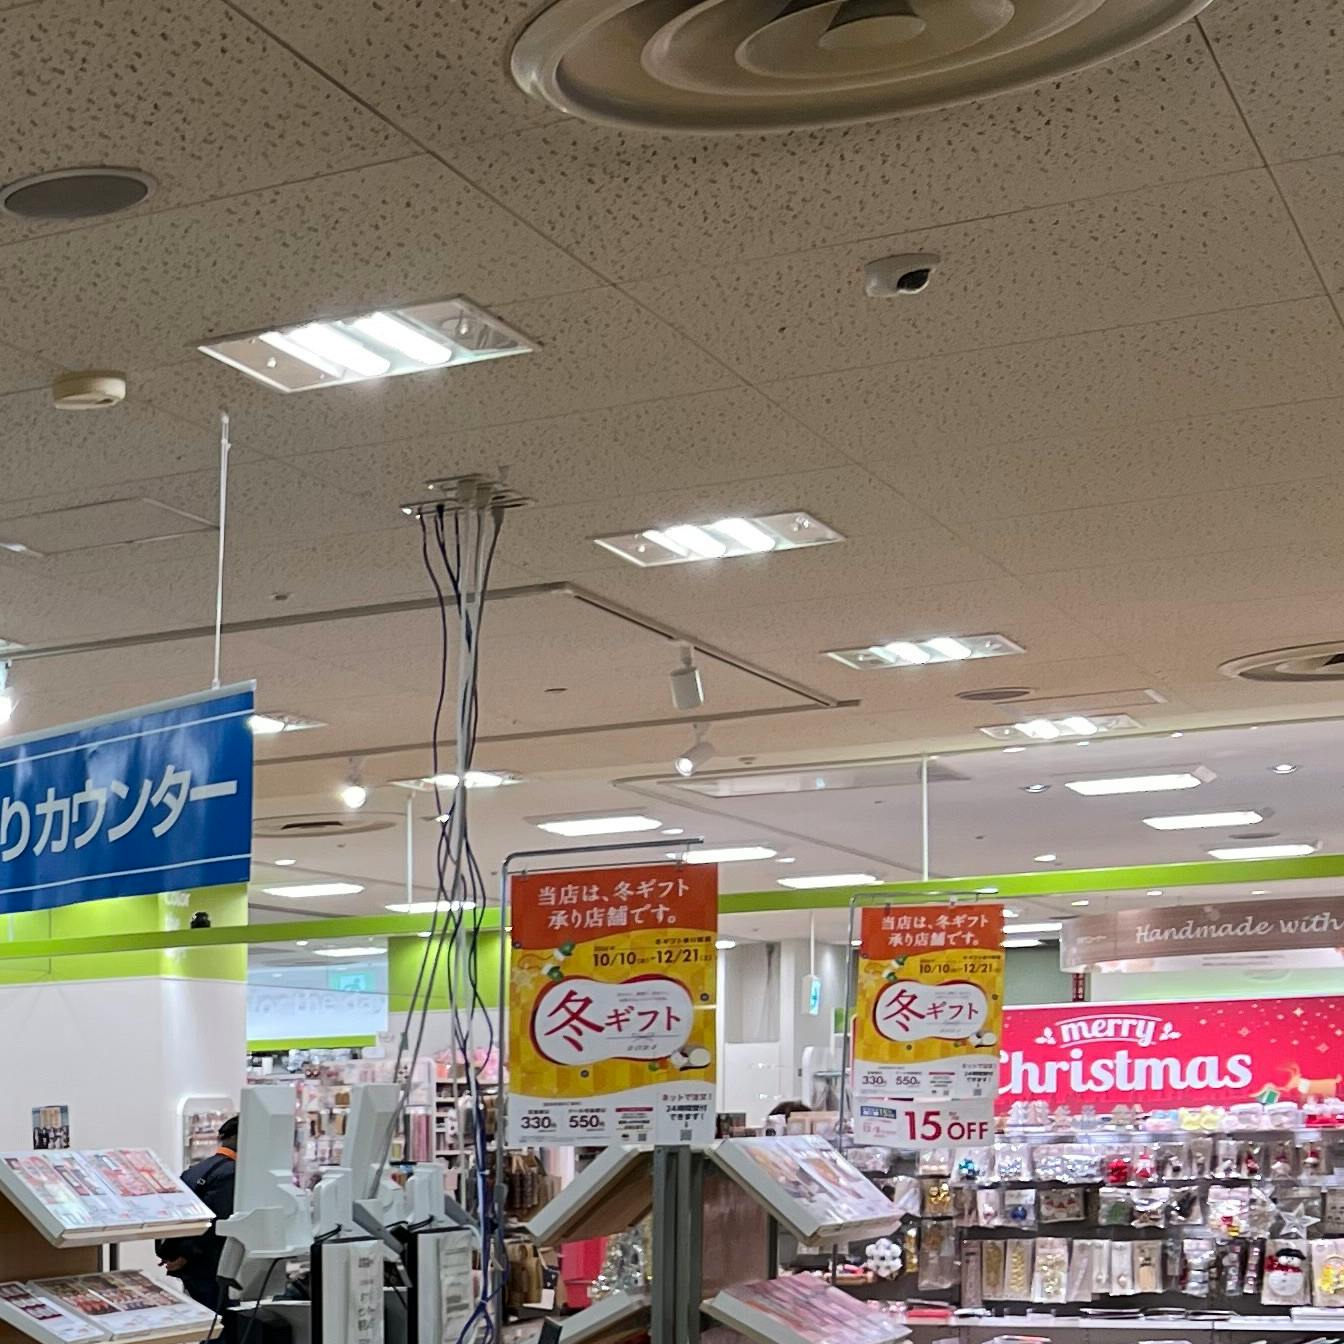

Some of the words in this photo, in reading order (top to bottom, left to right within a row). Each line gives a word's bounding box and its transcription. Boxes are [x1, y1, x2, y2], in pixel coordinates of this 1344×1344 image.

[537, 878, 690, 907] 当店は、冬ギフト
[547, 903, 678, 930] 承り店舗です。
[880, 914, 989, 931] 当店は、冬ギフト
[1135, 915, 1274, 945] Handmade
[1279, 911, 1344, 934] with
[887, 931, 980, 947] 承り店舗です。
[543, 988, 682, 1053] 冬ギフト
[882, 988, 980, 1032] 冬ギフト
[1059, 1017, 1159, 1047] merry
[903, 1110, 942, 1141] 15
[946, 1121, 989, 1140] OFF
